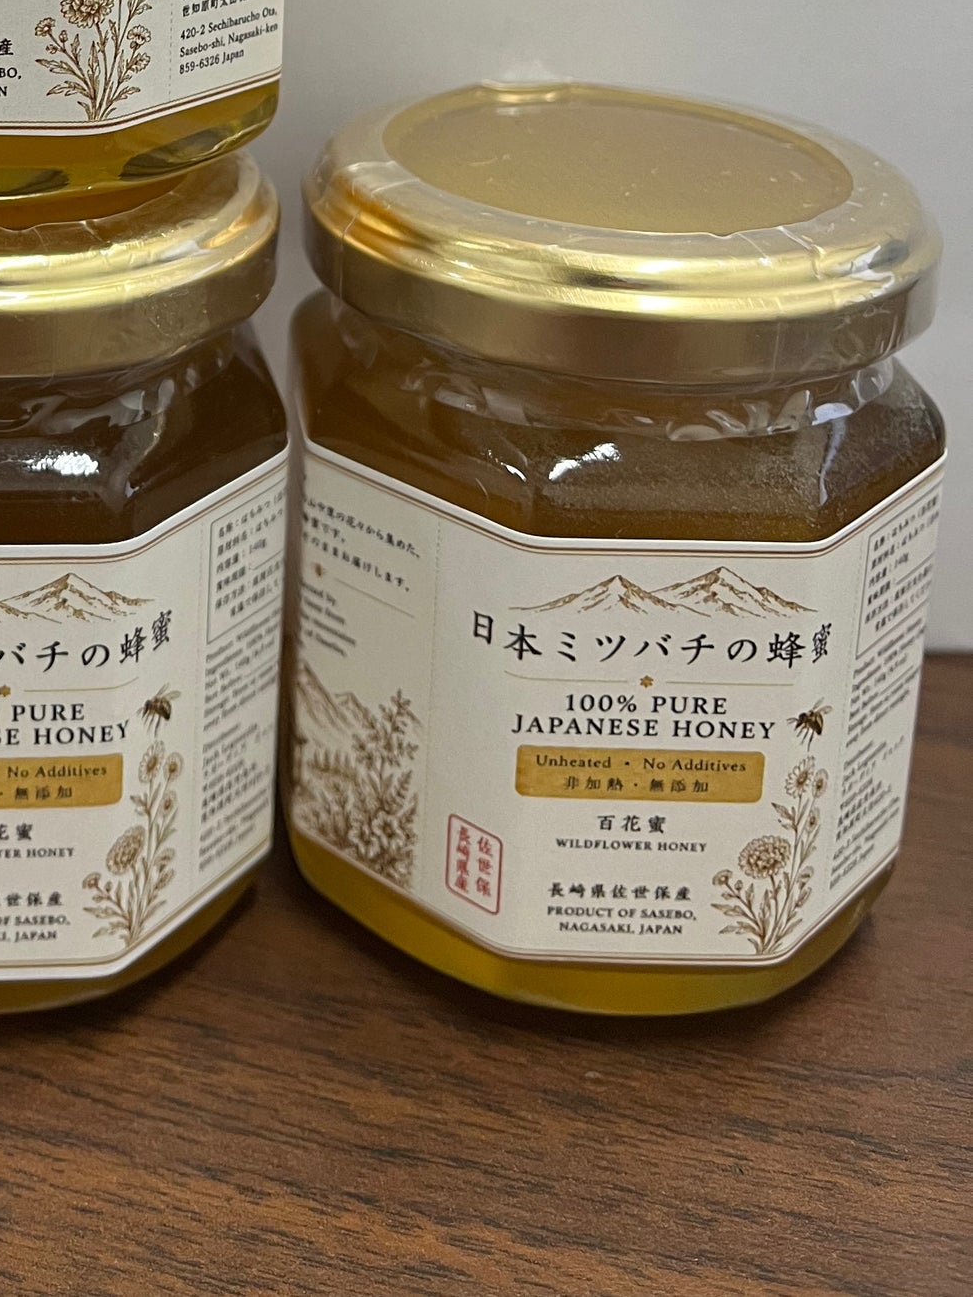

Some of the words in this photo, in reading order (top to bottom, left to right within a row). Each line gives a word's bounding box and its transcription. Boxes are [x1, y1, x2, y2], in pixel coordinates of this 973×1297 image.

[180, 23, 206, 41] 420-2
[228, 22, 278, 45] Nagasaki-ken
[179, 53, 220, 75] 859-6326
[222, 48, 245, 65] Japan
[472, 610, 832, 669] 日本ミツバチの蜂蜜
[11, 703, 85, 723] PURE
[565, 693, 638, 713] 100%
[650, 695, 728, 716] PURE
[33, 720, 129, 746] HONEY
[511, 714, 660, 737] JAPANESE
[671, 719, 776, 739] HONEY
[7, 766, 30, 780] No
[35, 764, 108, 779] Additives
[535, 754, 612, 769] Unheated
[642, 757, 666, 771] No
[671, 758, 747, 773] Additives
[597, 815, 667, 834] 百花蜜
[26, 847, 75, 859] HONEY
[556, 838, 653, 852] WILDFLOWER
[657, 840, 708, 853] HONEY
[14, 914, 70, 927] SASEBO,
[547, 906, 614, 919] PRODUCT
[617, 907, 636, 919] OF
[640, 908, 697, 921] SASEBO,
[14, 930, 57, 943] JAPAN
[639, 923, 683, 935] JAPAN
